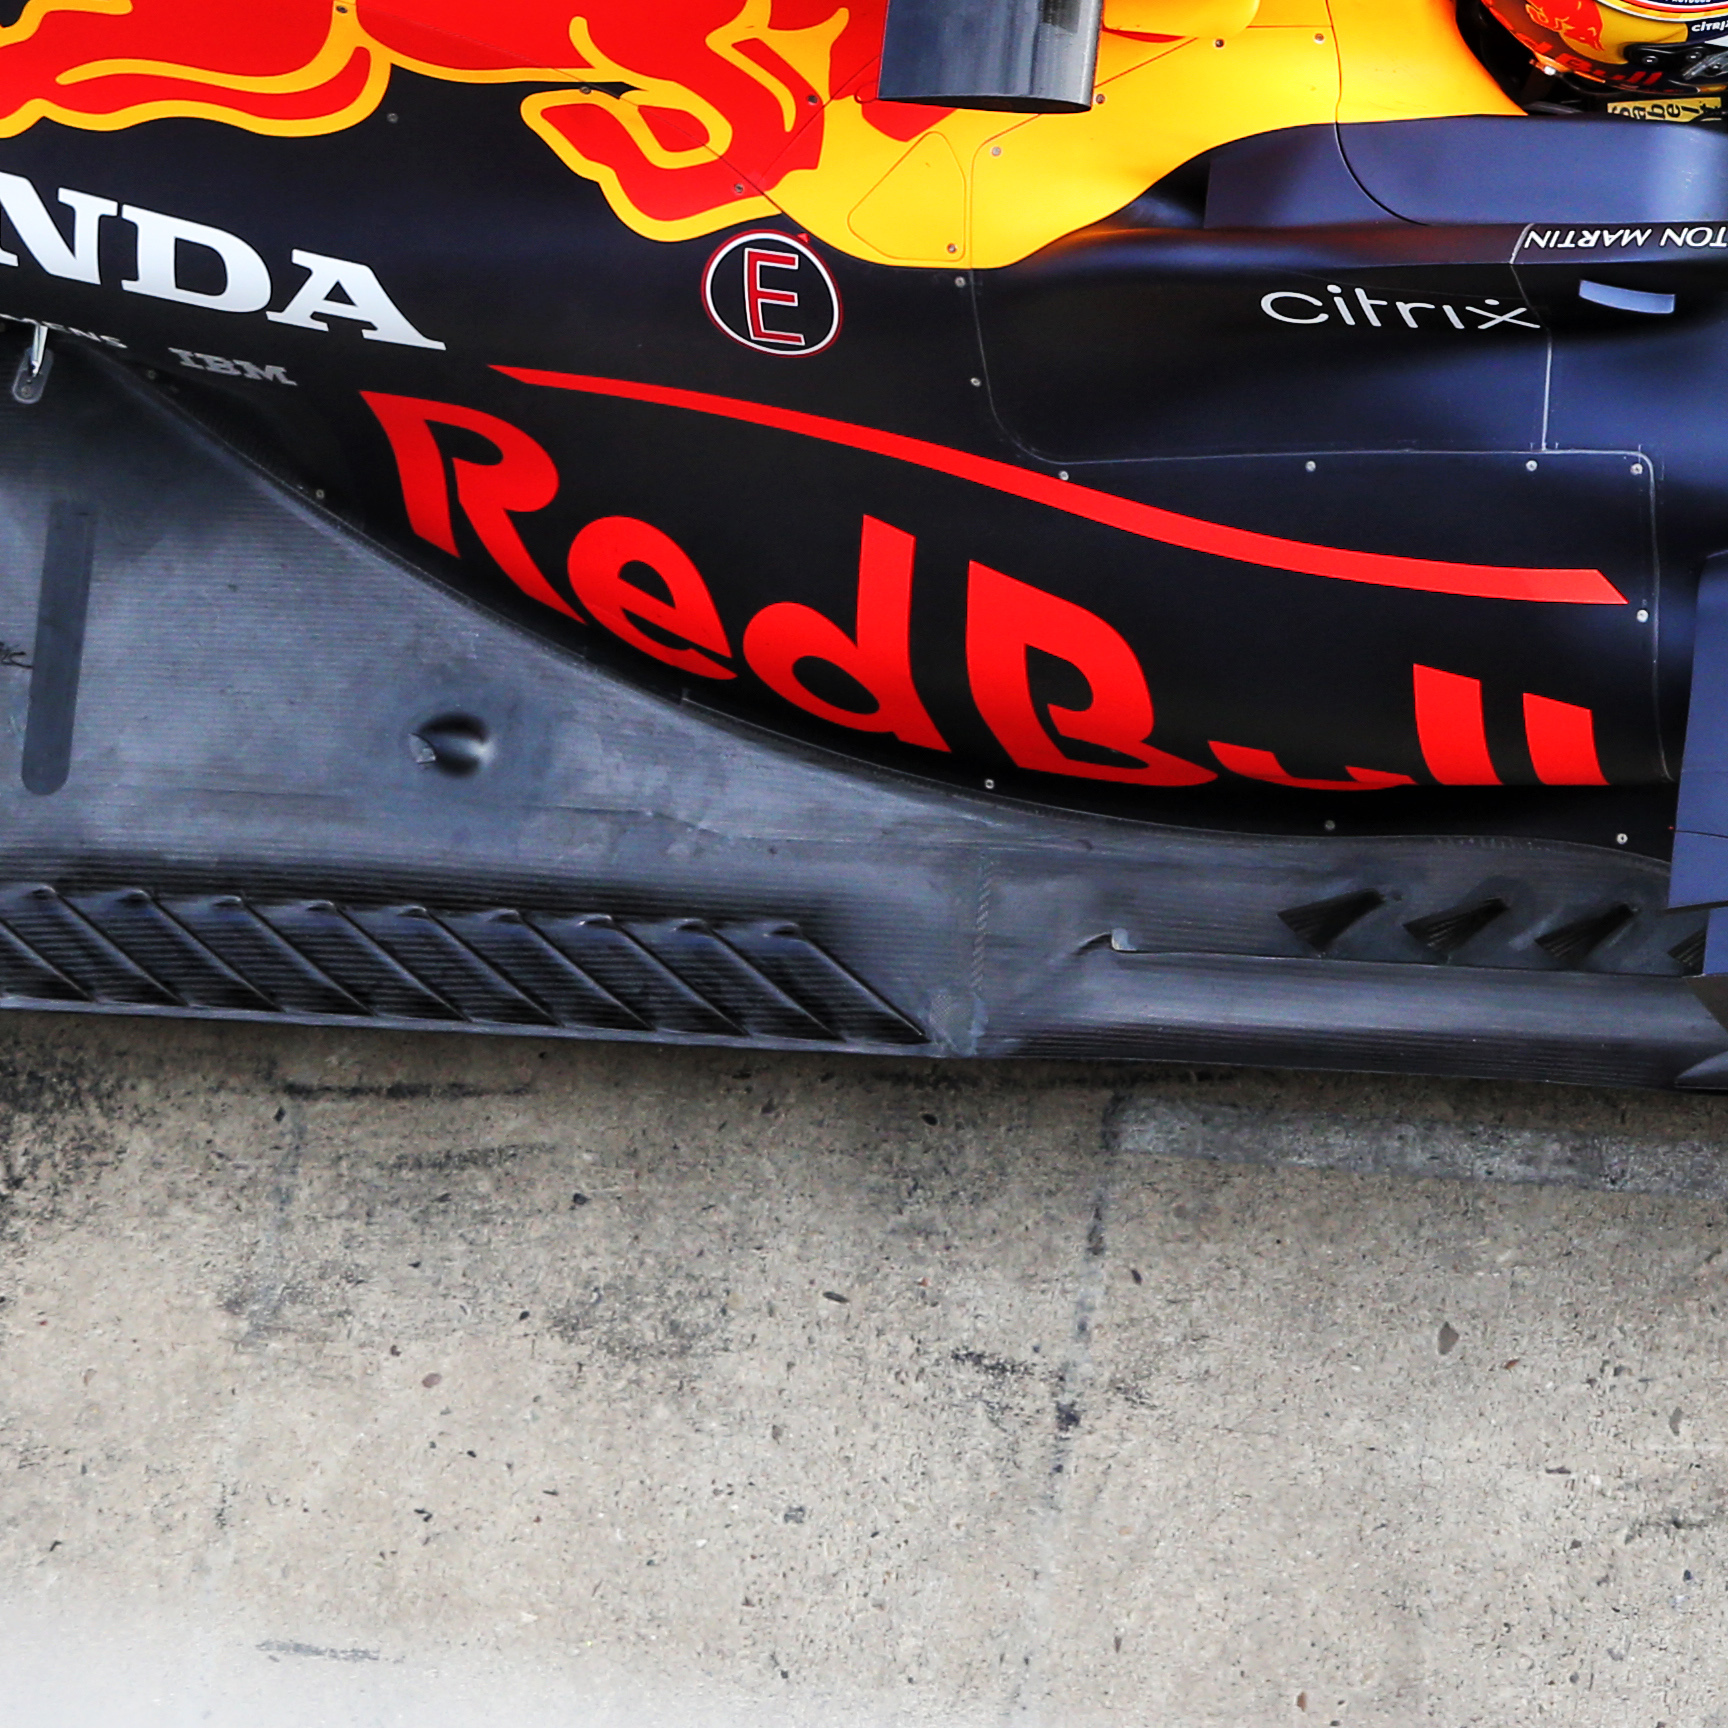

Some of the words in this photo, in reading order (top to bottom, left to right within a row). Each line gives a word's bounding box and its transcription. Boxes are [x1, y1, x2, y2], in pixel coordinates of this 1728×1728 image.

[1525, 226, 1649, 250] MARTIN
[1260, 283, 1542, 330] Citrix
[168, 347, 298, 387] IBM
[358, 389, 954, 755] Red
